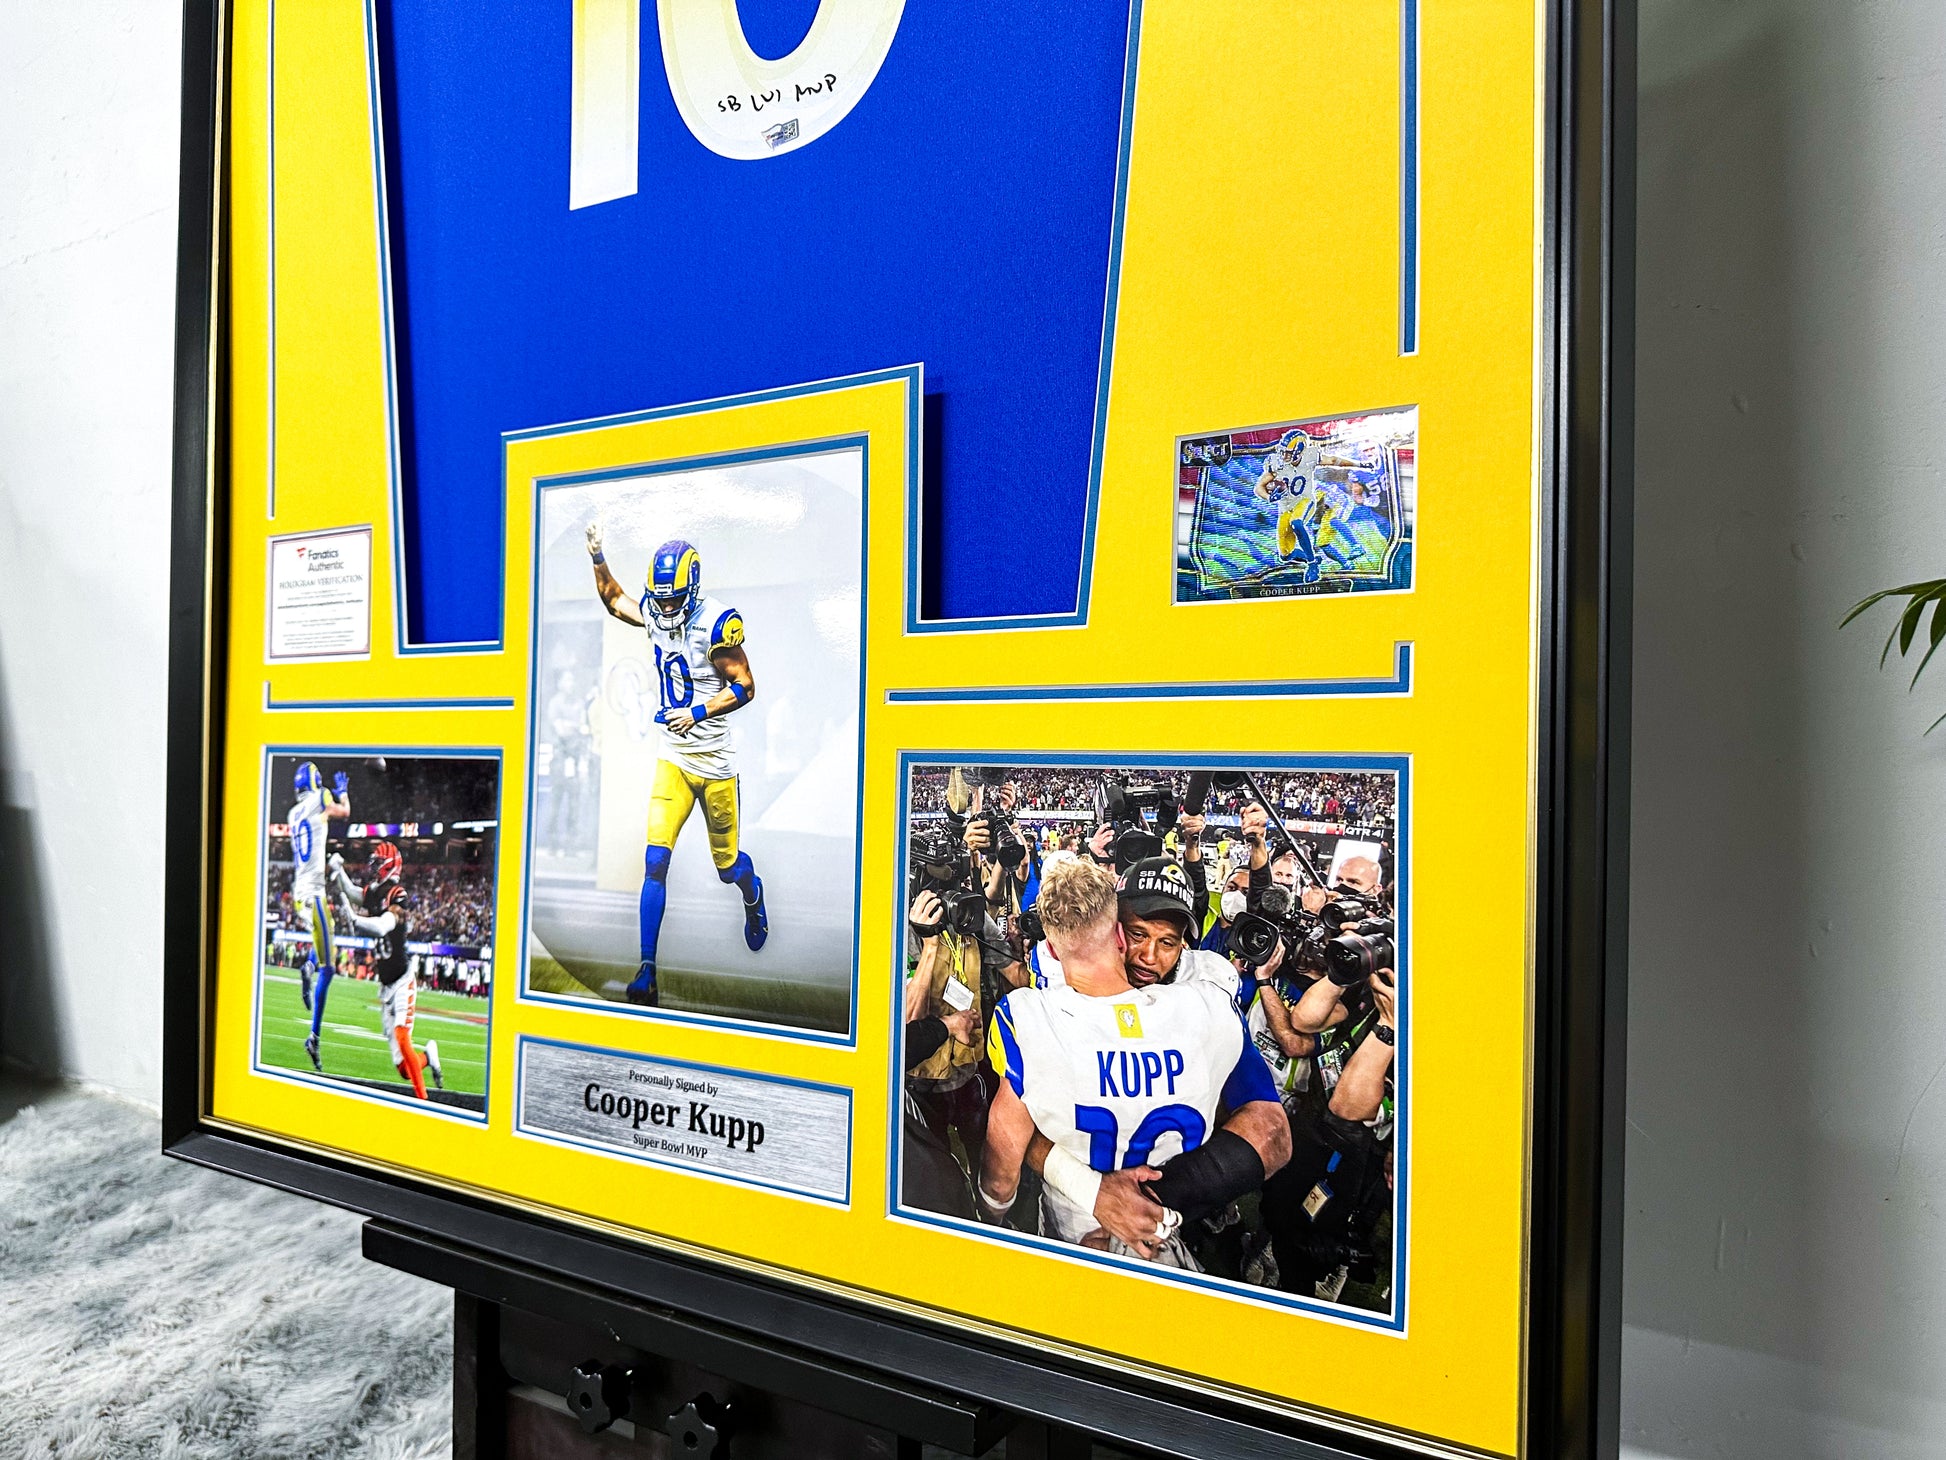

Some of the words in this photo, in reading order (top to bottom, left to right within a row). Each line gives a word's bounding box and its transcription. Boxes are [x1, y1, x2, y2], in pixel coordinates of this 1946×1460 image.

[718, 95, 741, 112] SB
[795, 73, 837, 102] MVP
[308, 549, 339, 560] Fanatics
[308, 561, 344, 572] Authentic
[279, 579, 315, 590] HOLOGRAM
[317, 574, 363, 586] VERIFICATION
[1260, 587, 1294, 597] COOPER
[1297, 586, 1321, 596] KUPP
[654, 644, 694, 709] 10
[1346, 826, 1371, 836] QTR
[1372, 829, 1382, 838] 4
[629, 1069, 674, 1090] Personally
[675, 1077, 706, 1094] Signed
[707, 1081, 719, 1097] by
[1097, 1049, 1184, 1098] KUPP
[584, 1083, 680, 1129] Cooper
[688, 1101, 765, 1153] Kupp
[633, 1133, 660, 1150] Super
[661, 1138, 685, 1155] Bowl
[686, 1144, 708, 1159] MVP
